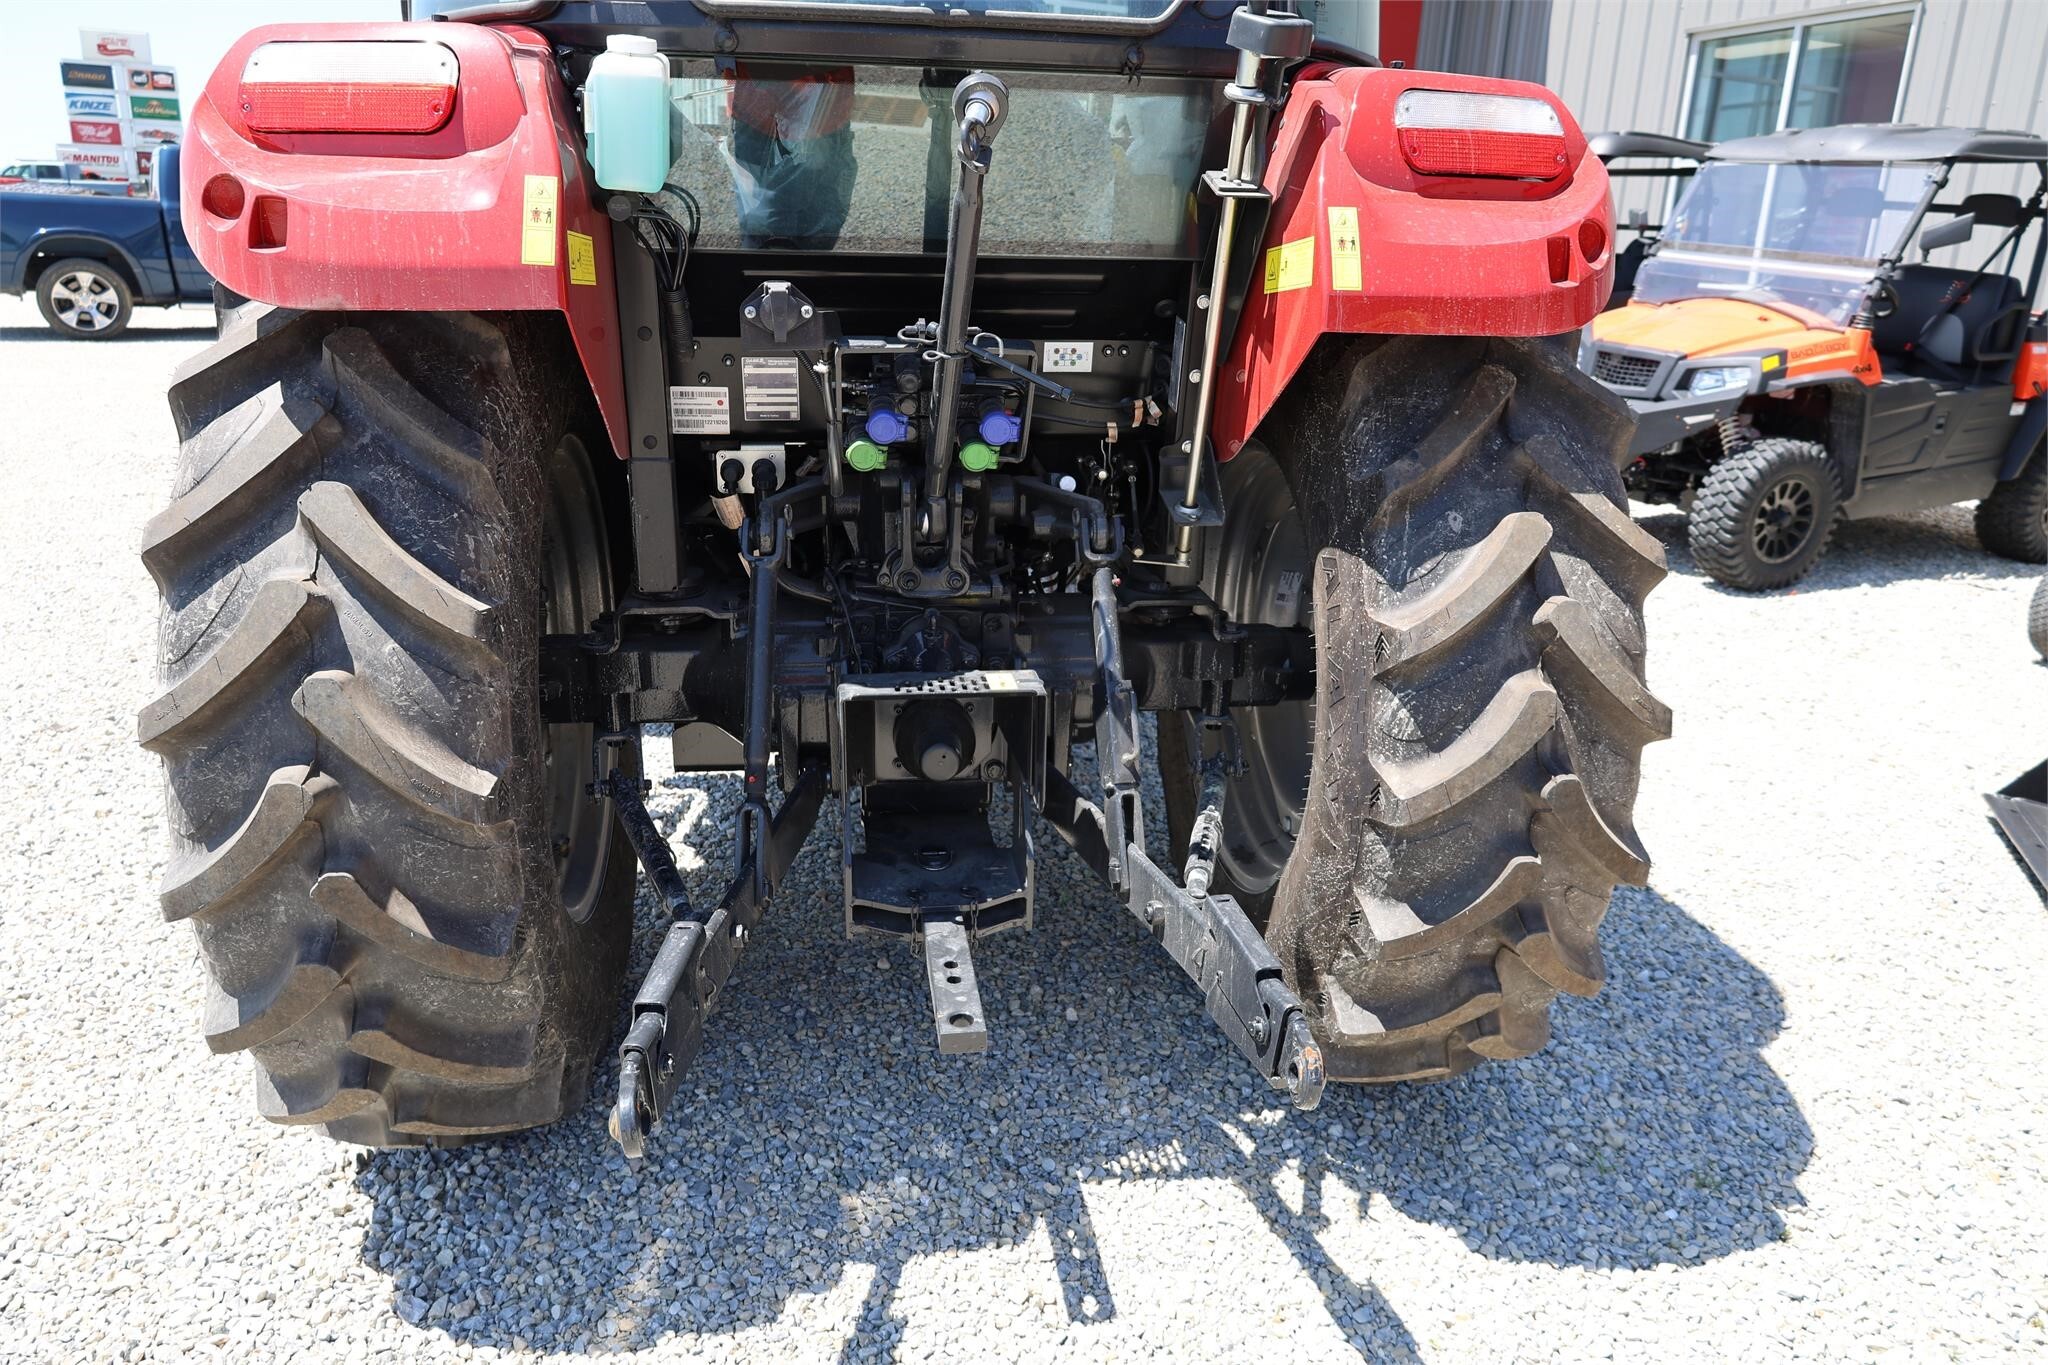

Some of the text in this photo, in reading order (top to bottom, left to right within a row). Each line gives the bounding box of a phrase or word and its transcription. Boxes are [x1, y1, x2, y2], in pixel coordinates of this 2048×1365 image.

[69, 99, 112, 111] KINZE
[72, 154, 120, 164] MANITOU
[1790, 342, 1848, 359] BAD BOY
